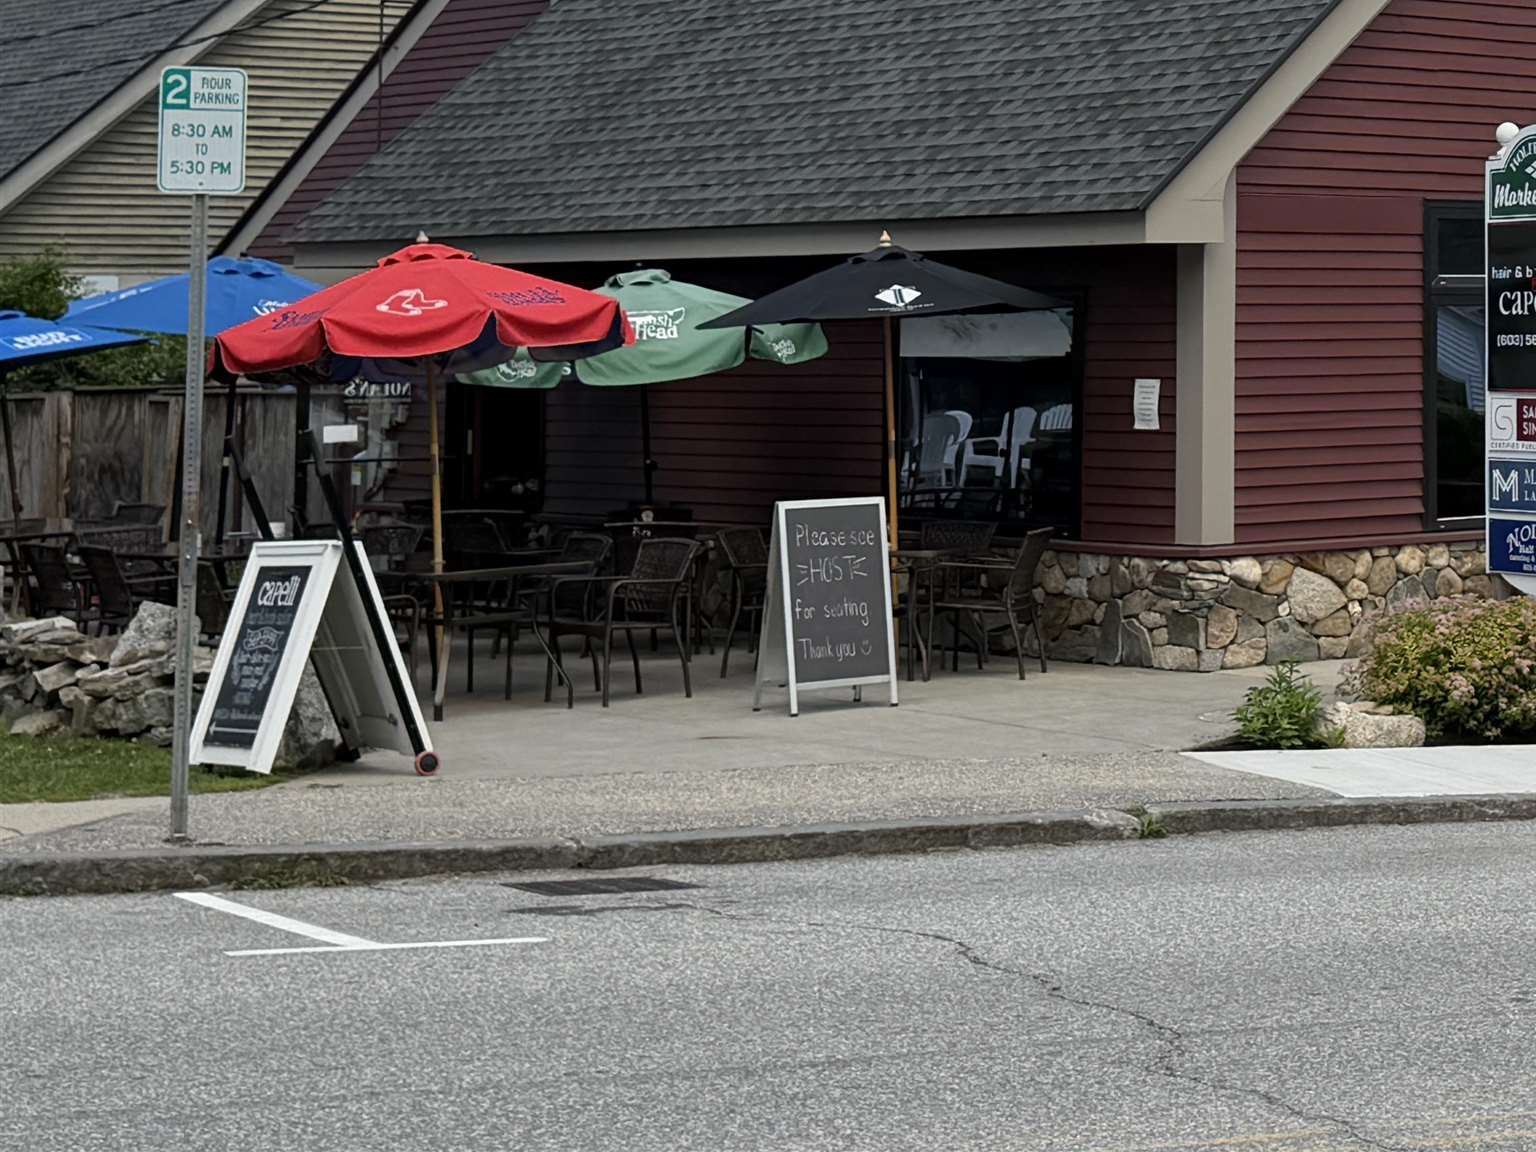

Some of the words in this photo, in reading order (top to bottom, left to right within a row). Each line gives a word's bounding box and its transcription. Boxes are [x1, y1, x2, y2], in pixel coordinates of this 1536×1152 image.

[166, 74, 188, 104] 2
[201, 77, 232, 90] HOUR
[193, 92, 240, 105] PARKING
[171, 123, 206, 138] 8:30
[211, 124, 233, 138] AM
[195, 143, 208, 156] TO
[170, 160, 205, 175] 5:30
[211, 161, 232, 175] PM
[1491, 266, 1512, 279] hair
[1515, 265, 1523, 278] &
[1497, 334, 1523, 347] (603)
[1492, 468, 1519, 502] M
[795, 524, 846, 547] Please
[849, 529, 875, 546] see
[809, 554, 857, 583] HOST
[257, 575, 301, 607] capelli
[795, 598, 816, 620] for
[824, 595, 869, 627] seating
[798, 636, 834, 661] Thank
[836, 640, 856, 663] you
